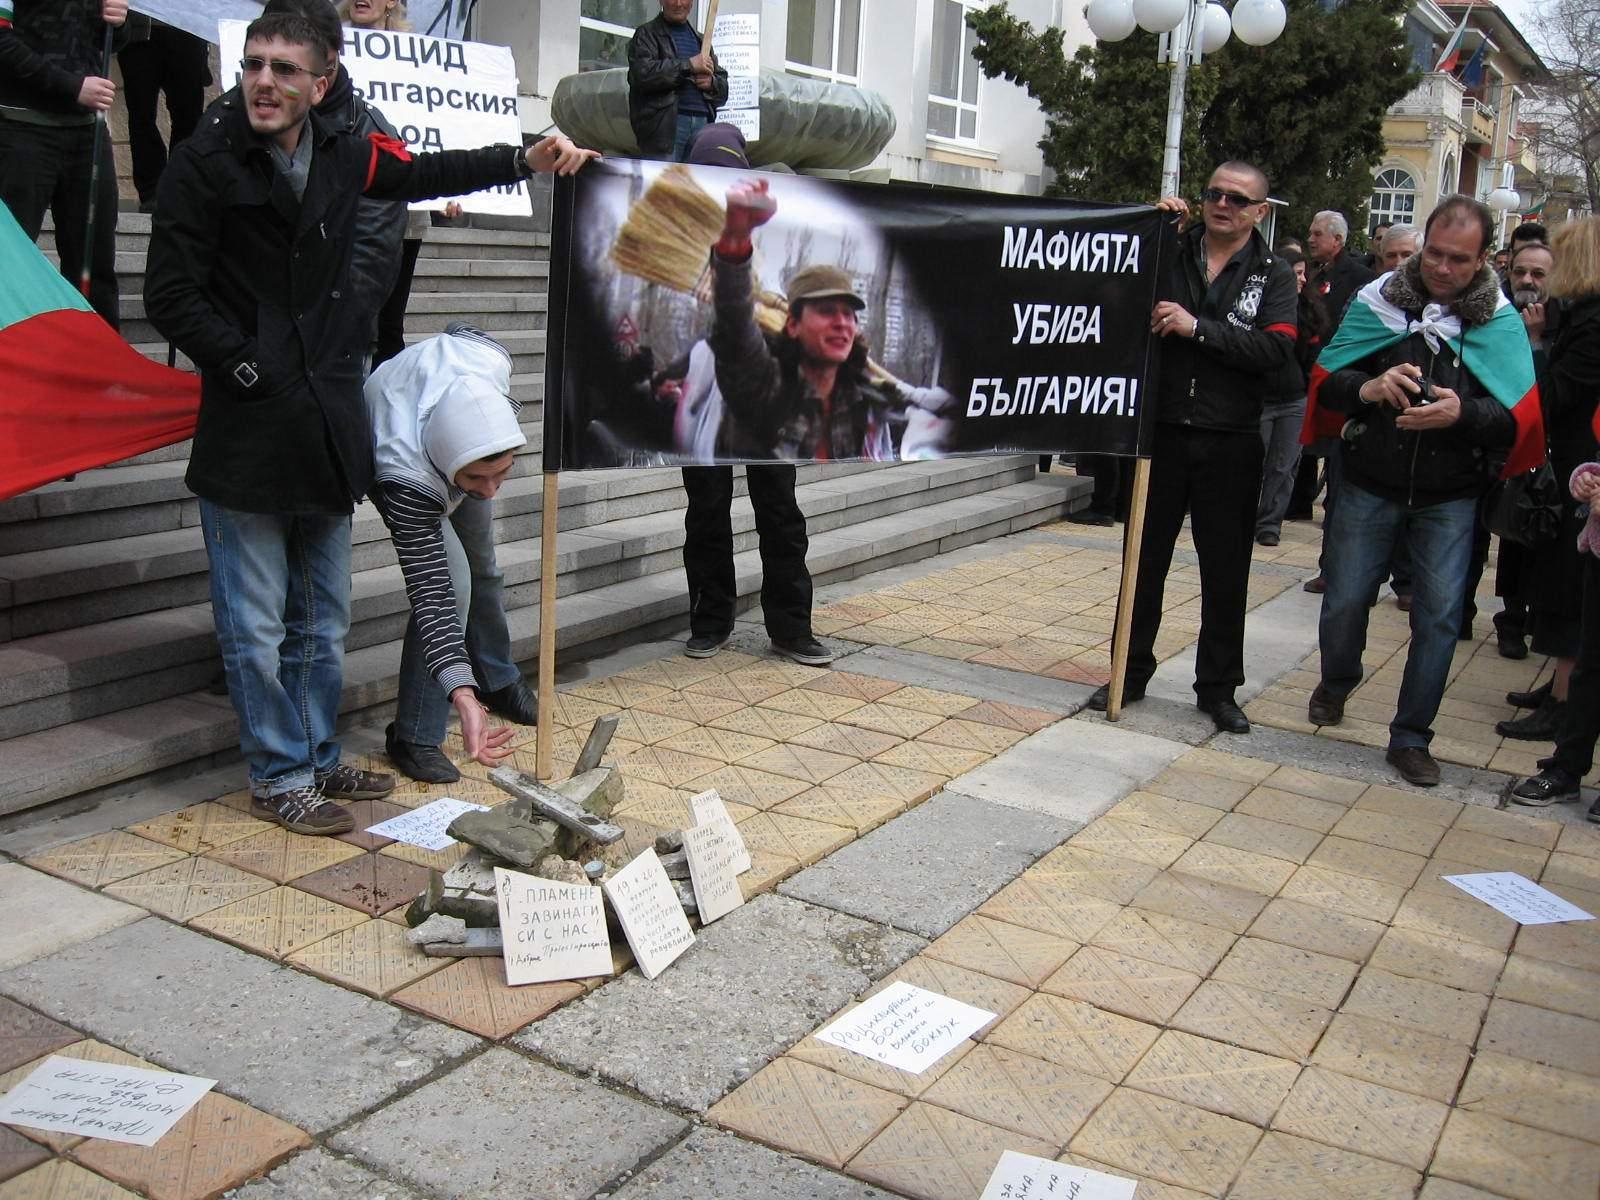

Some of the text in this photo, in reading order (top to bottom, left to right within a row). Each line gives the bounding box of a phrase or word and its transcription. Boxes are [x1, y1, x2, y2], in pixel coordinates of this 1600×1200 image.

[352, 78, 518, 116] ългарския
[1000, 226, 1140, 273] МАФИЯТА
[1012, 304, 1101, 344] УБИВА
[966, 376, 1138, 417] БЪЛГАРИЯ!
[518, 929, 535, 943] СИ
[544, 928, 552, 940] С
